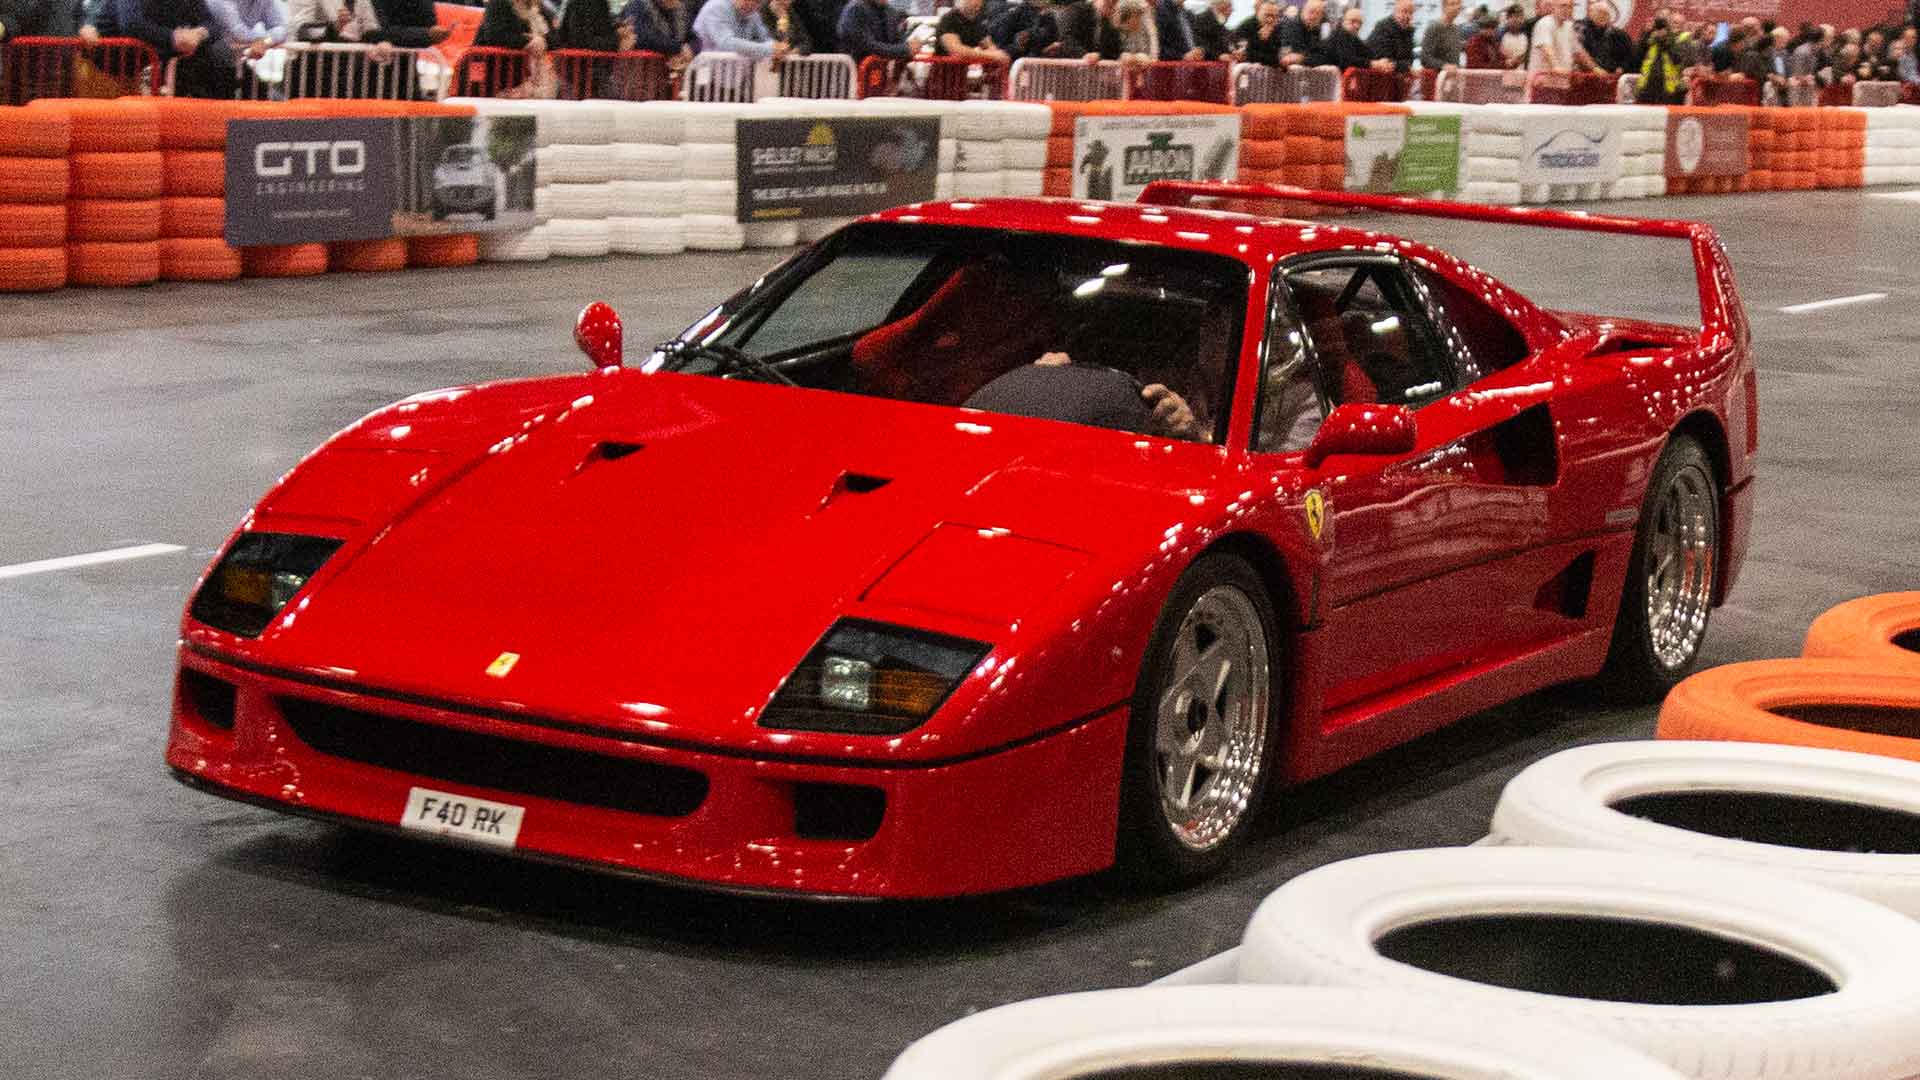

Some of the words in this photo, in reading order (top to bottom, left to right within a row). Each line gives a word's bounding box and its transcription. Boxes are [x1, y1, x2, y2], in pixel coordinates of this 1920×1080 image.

[256, 141, 365, 176] GTO
[1128, 150, 1192, 174] AARON
[419, 797, 467, 827] F40
[472, 807, 507, 834] RK
